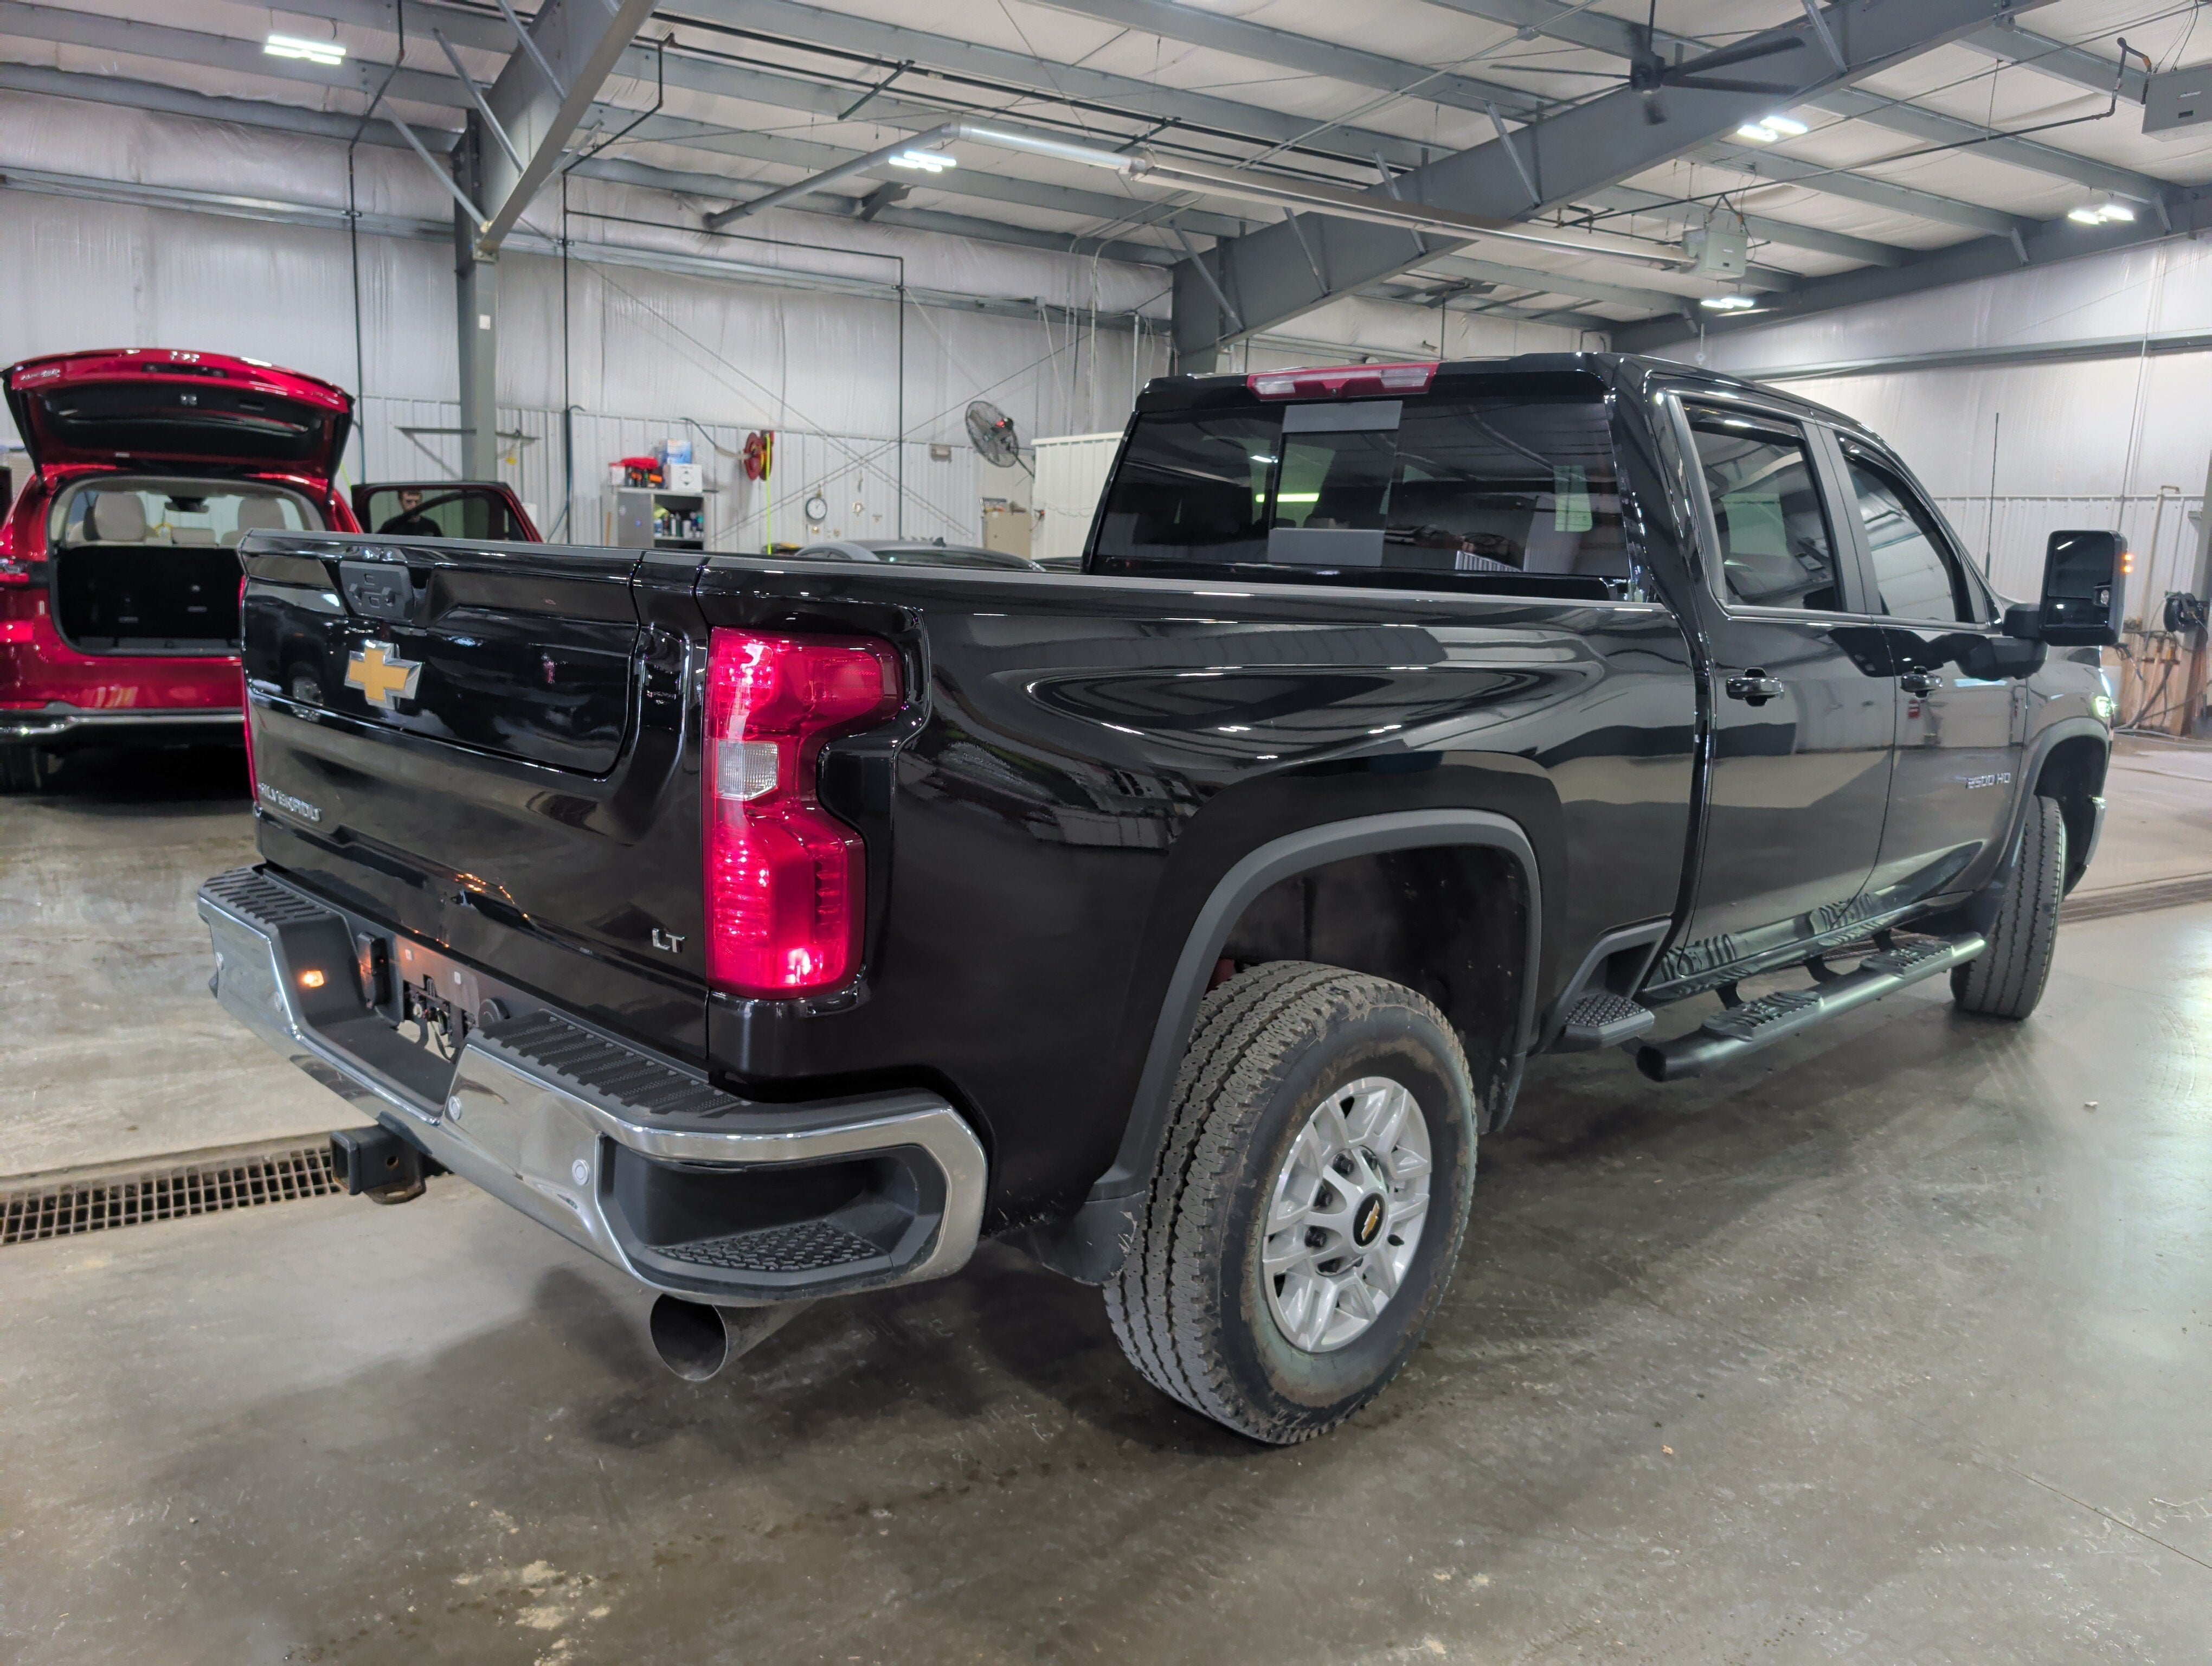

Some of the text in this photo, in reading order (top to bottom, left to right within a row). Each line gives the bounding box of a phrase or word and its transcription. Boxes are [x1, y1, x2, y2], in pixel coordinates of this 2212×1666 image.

[1967, 772, 2011, 789] 2500 HD
[652, 927, 685, 953] LT
